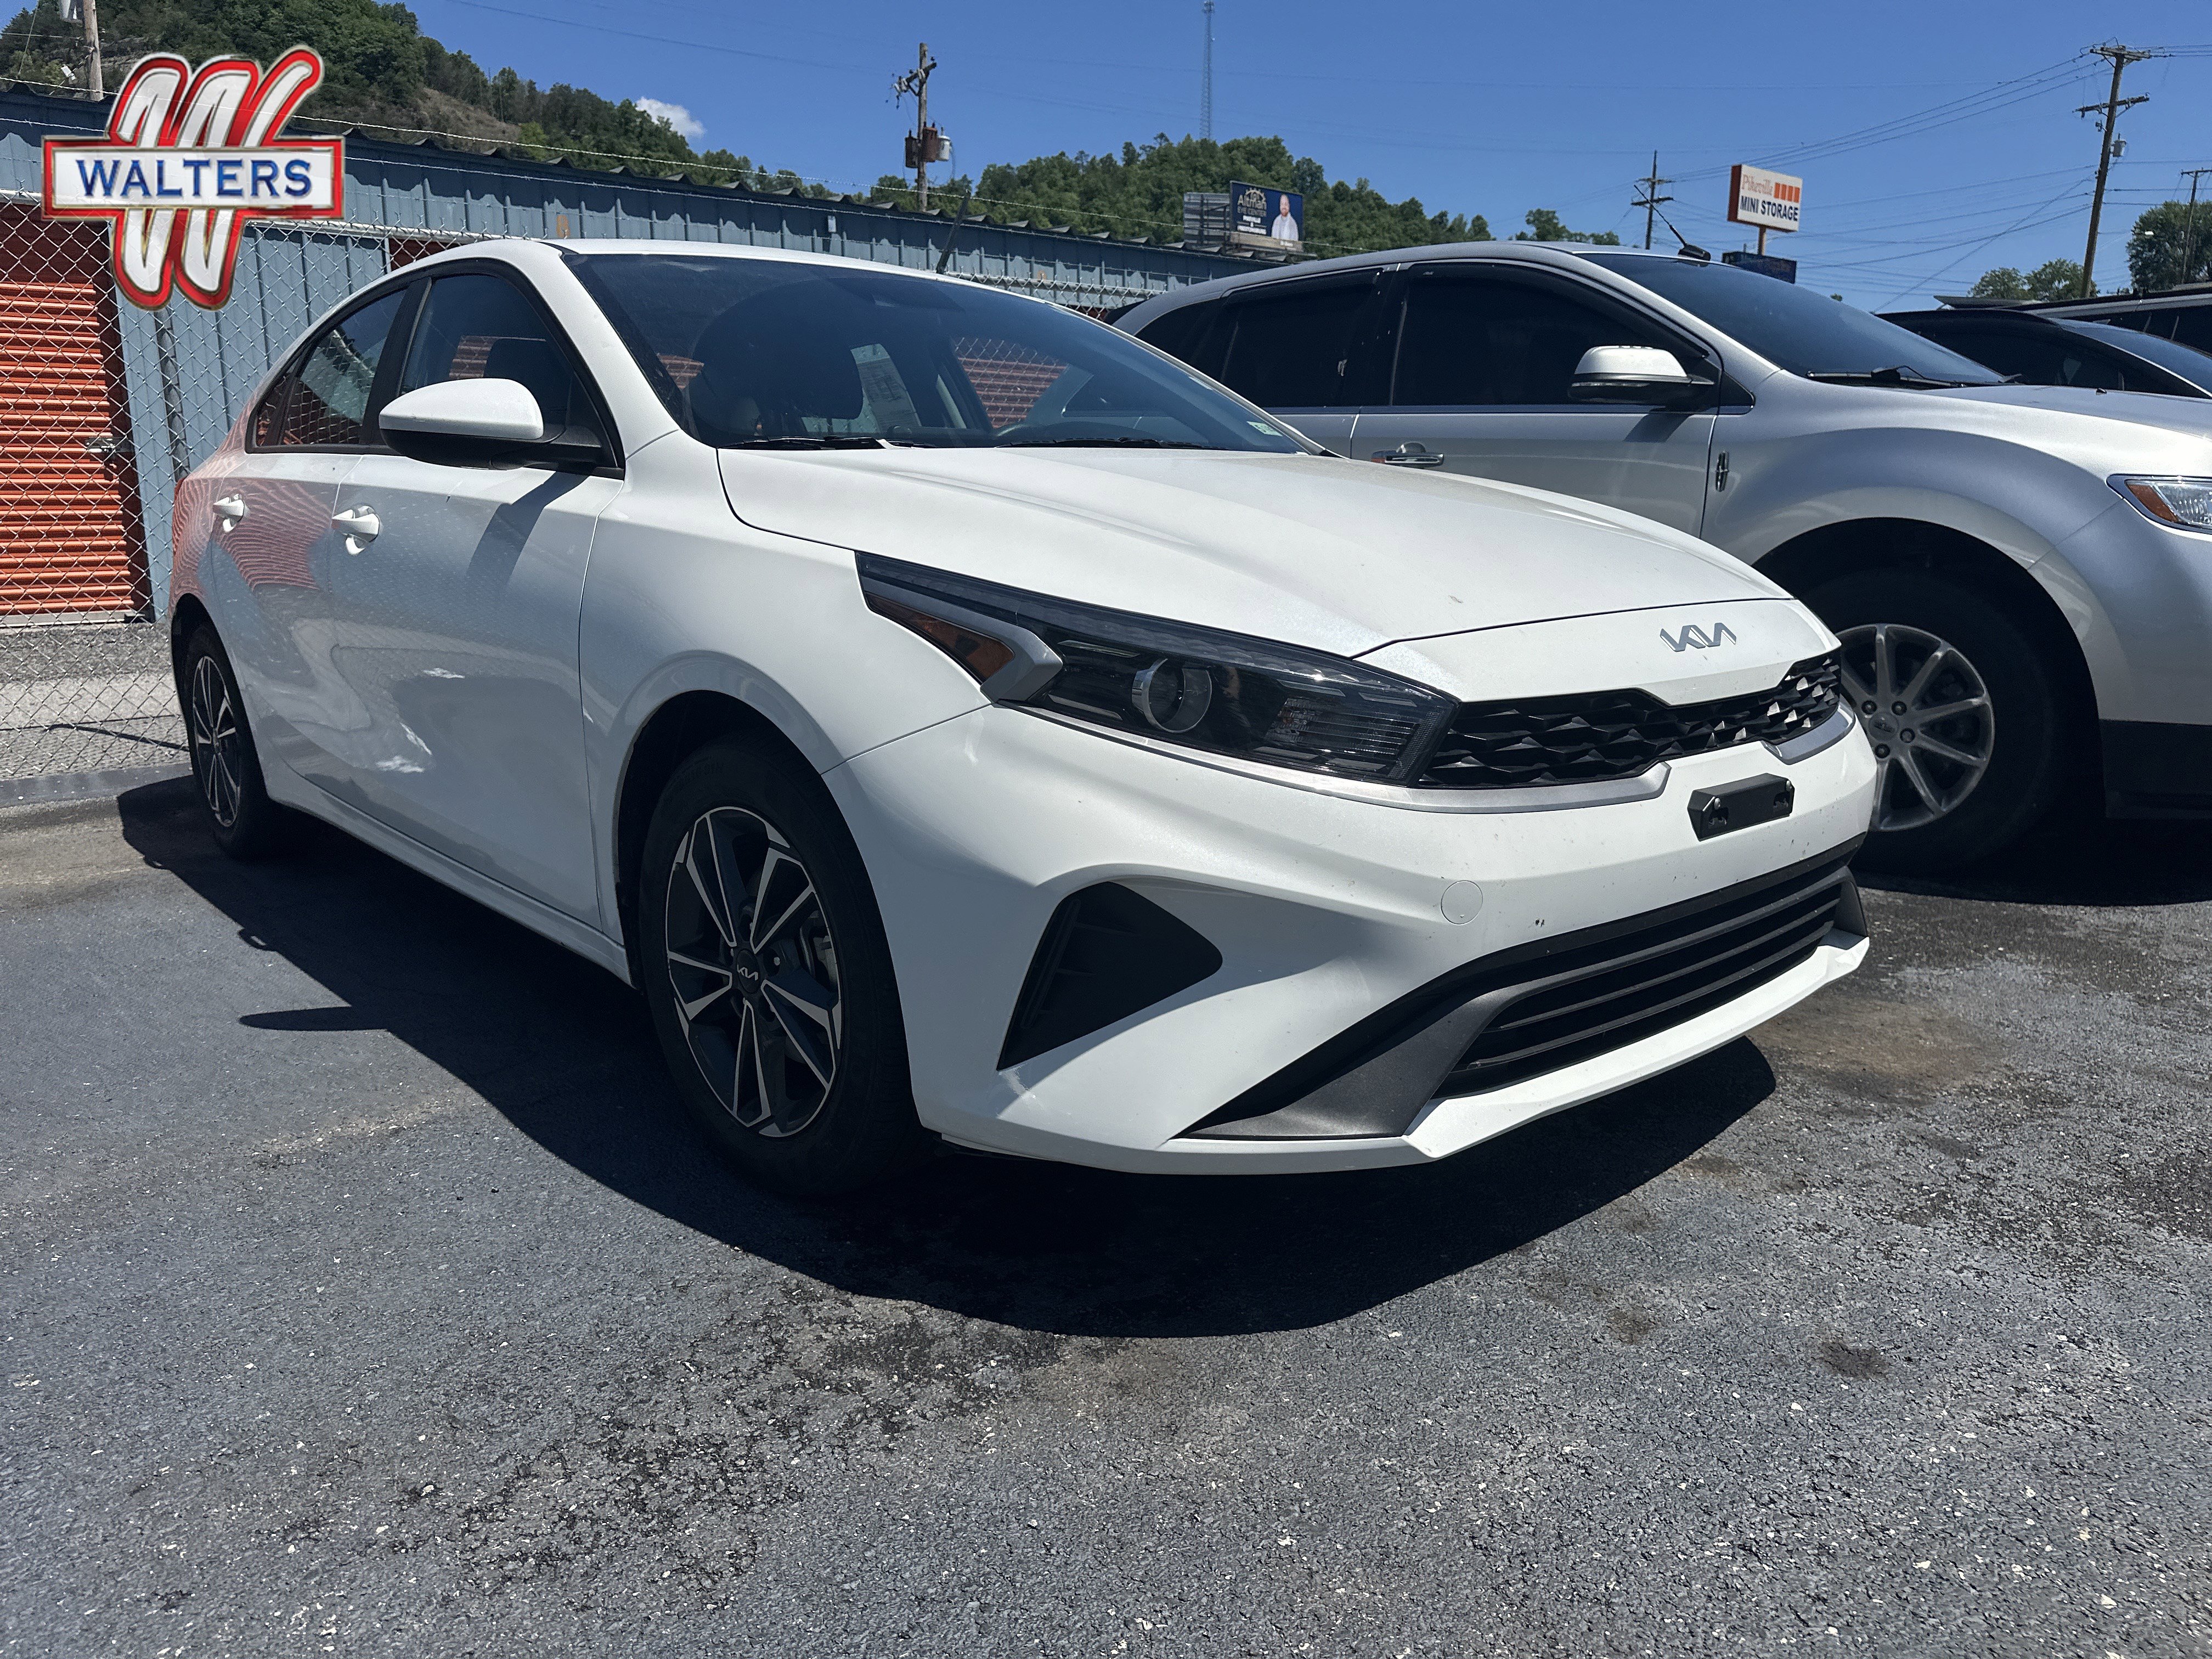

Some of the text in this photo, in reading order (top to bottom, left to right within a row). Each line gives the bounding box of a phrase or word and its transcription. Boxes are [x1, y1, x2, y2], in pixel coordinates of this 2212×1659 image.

[1740, 195, 1799, 222] MINI STORAGE
[1660, 622, 1737, 652] KIA
[737, 964, 759, 981] KIA
